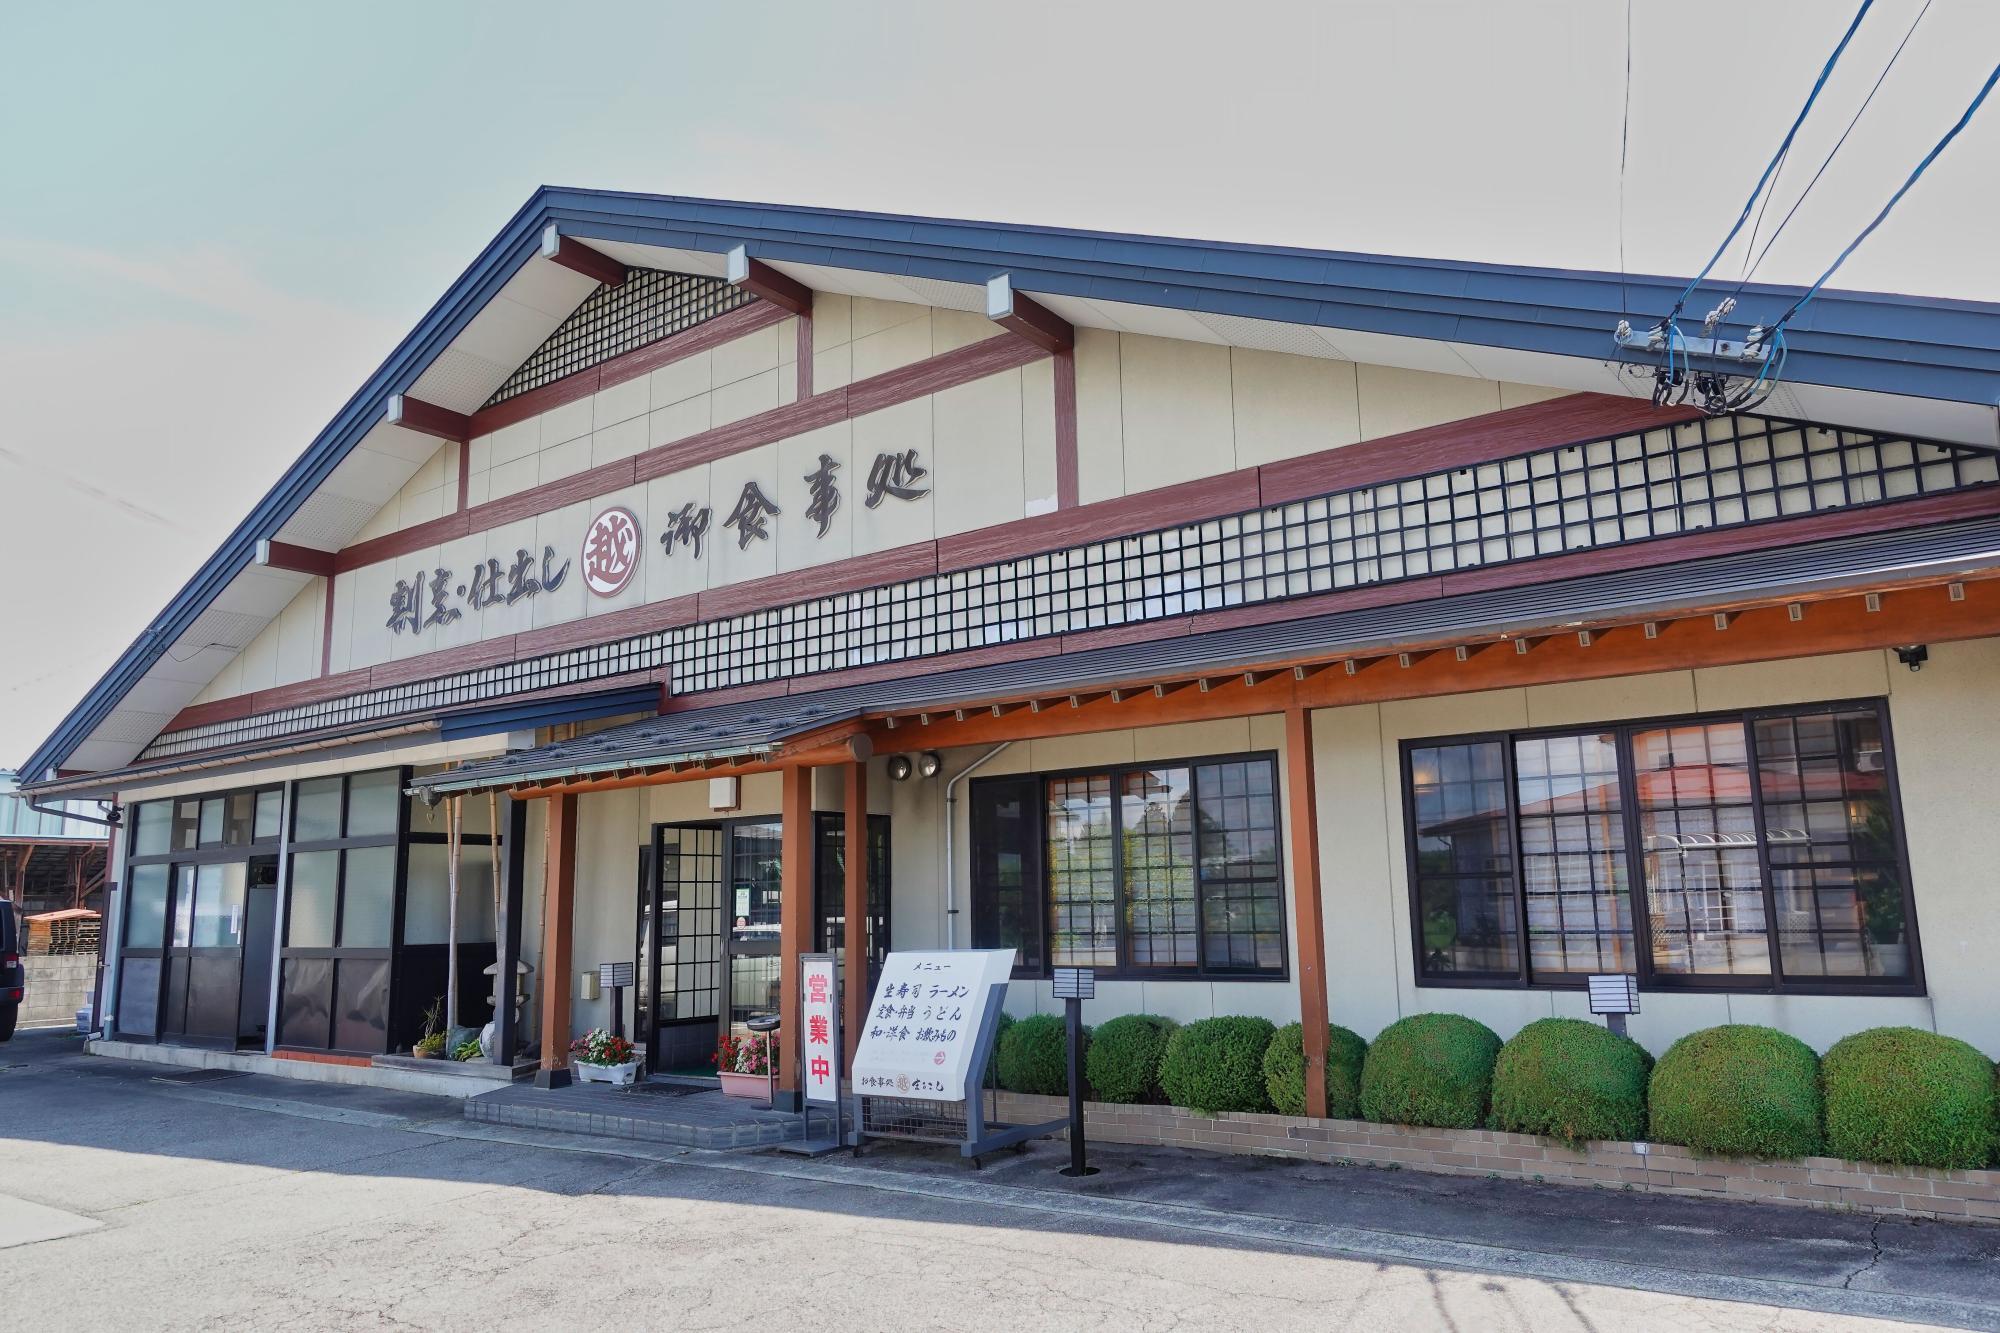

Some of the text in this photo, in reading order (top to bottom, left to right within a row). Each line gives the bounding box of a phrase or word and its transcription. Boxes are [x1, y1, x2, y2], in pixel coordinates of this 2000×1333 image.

[660, 449, 932, 560] 御食事処
[913, 962, 951, 971] メニュー
[884, 982, 969, 999] 生寿司 ラーメン
[923, 1005, 962, 1021] うどん
[808, 974, 830, 1085] 営業中
[915, 1027, 956, 1042] お飲みもの
